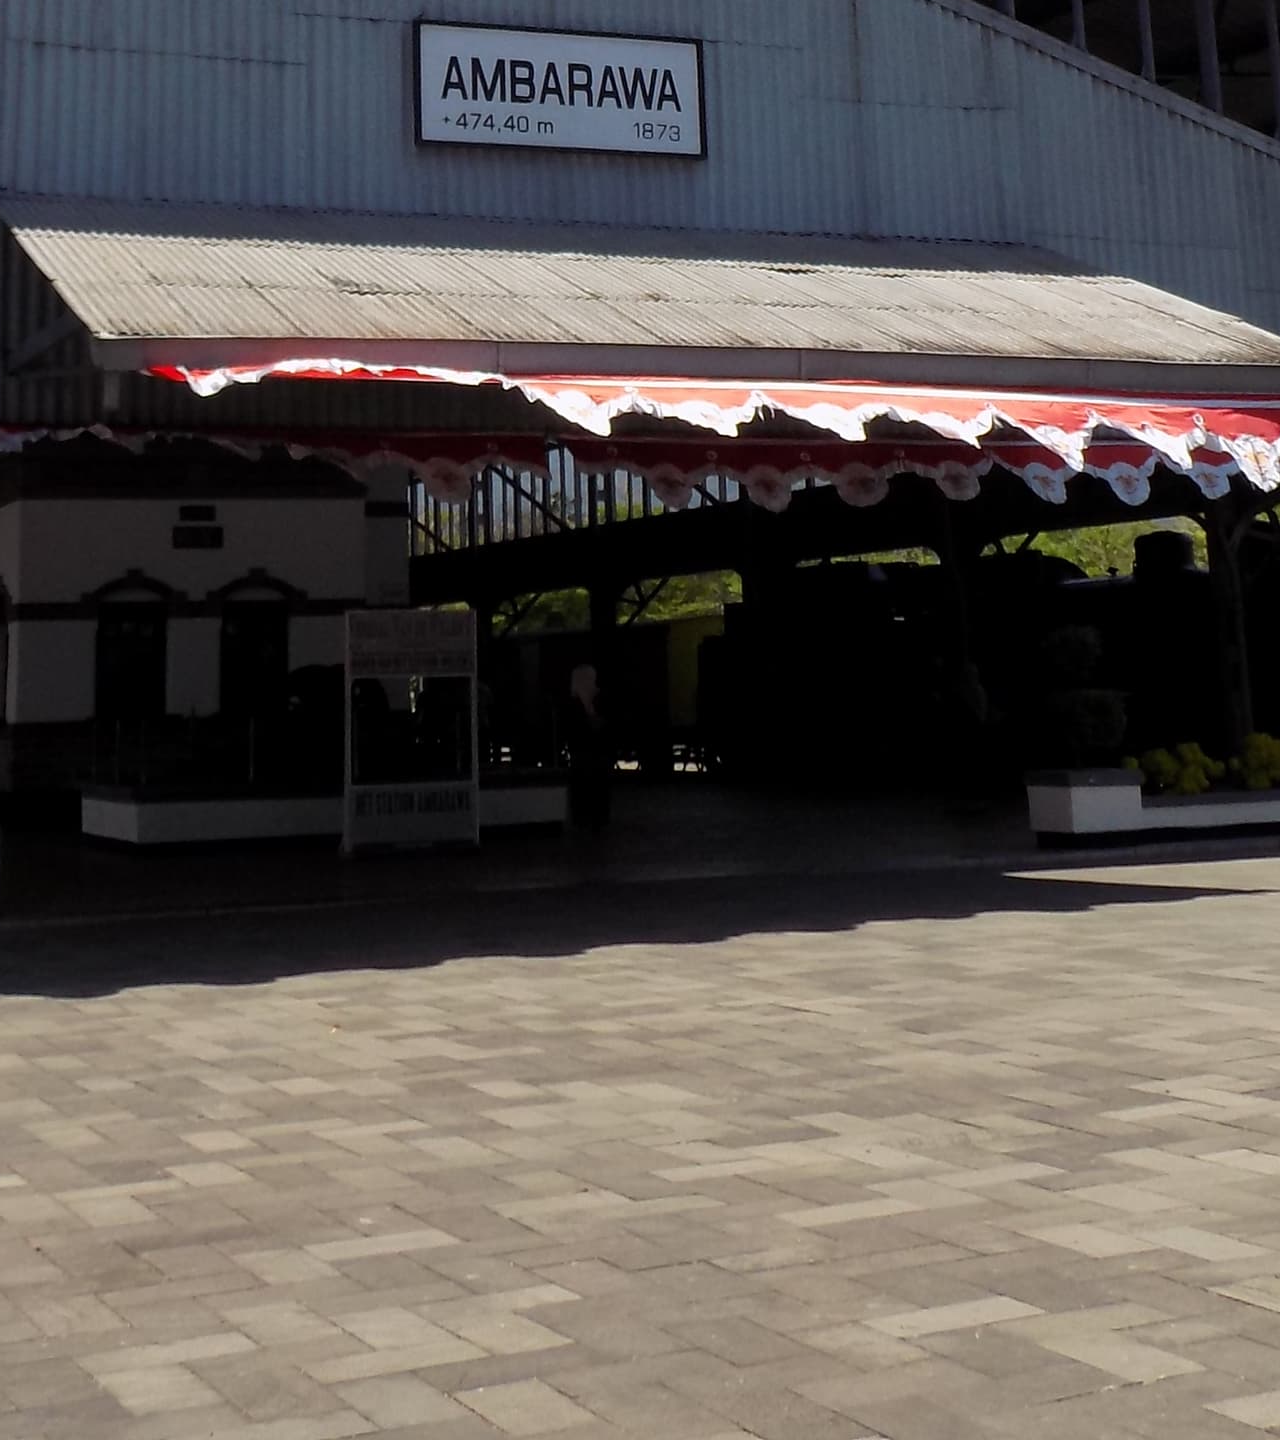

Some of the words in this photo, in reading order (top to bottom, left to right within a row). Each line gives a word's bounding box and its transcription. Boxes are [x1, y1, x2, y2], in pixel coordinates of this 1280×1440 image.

[441, 55, 682, 112] AMBARAWA
[537, 120, 554, 134] m
[632, 122, 681, 142] 1873
